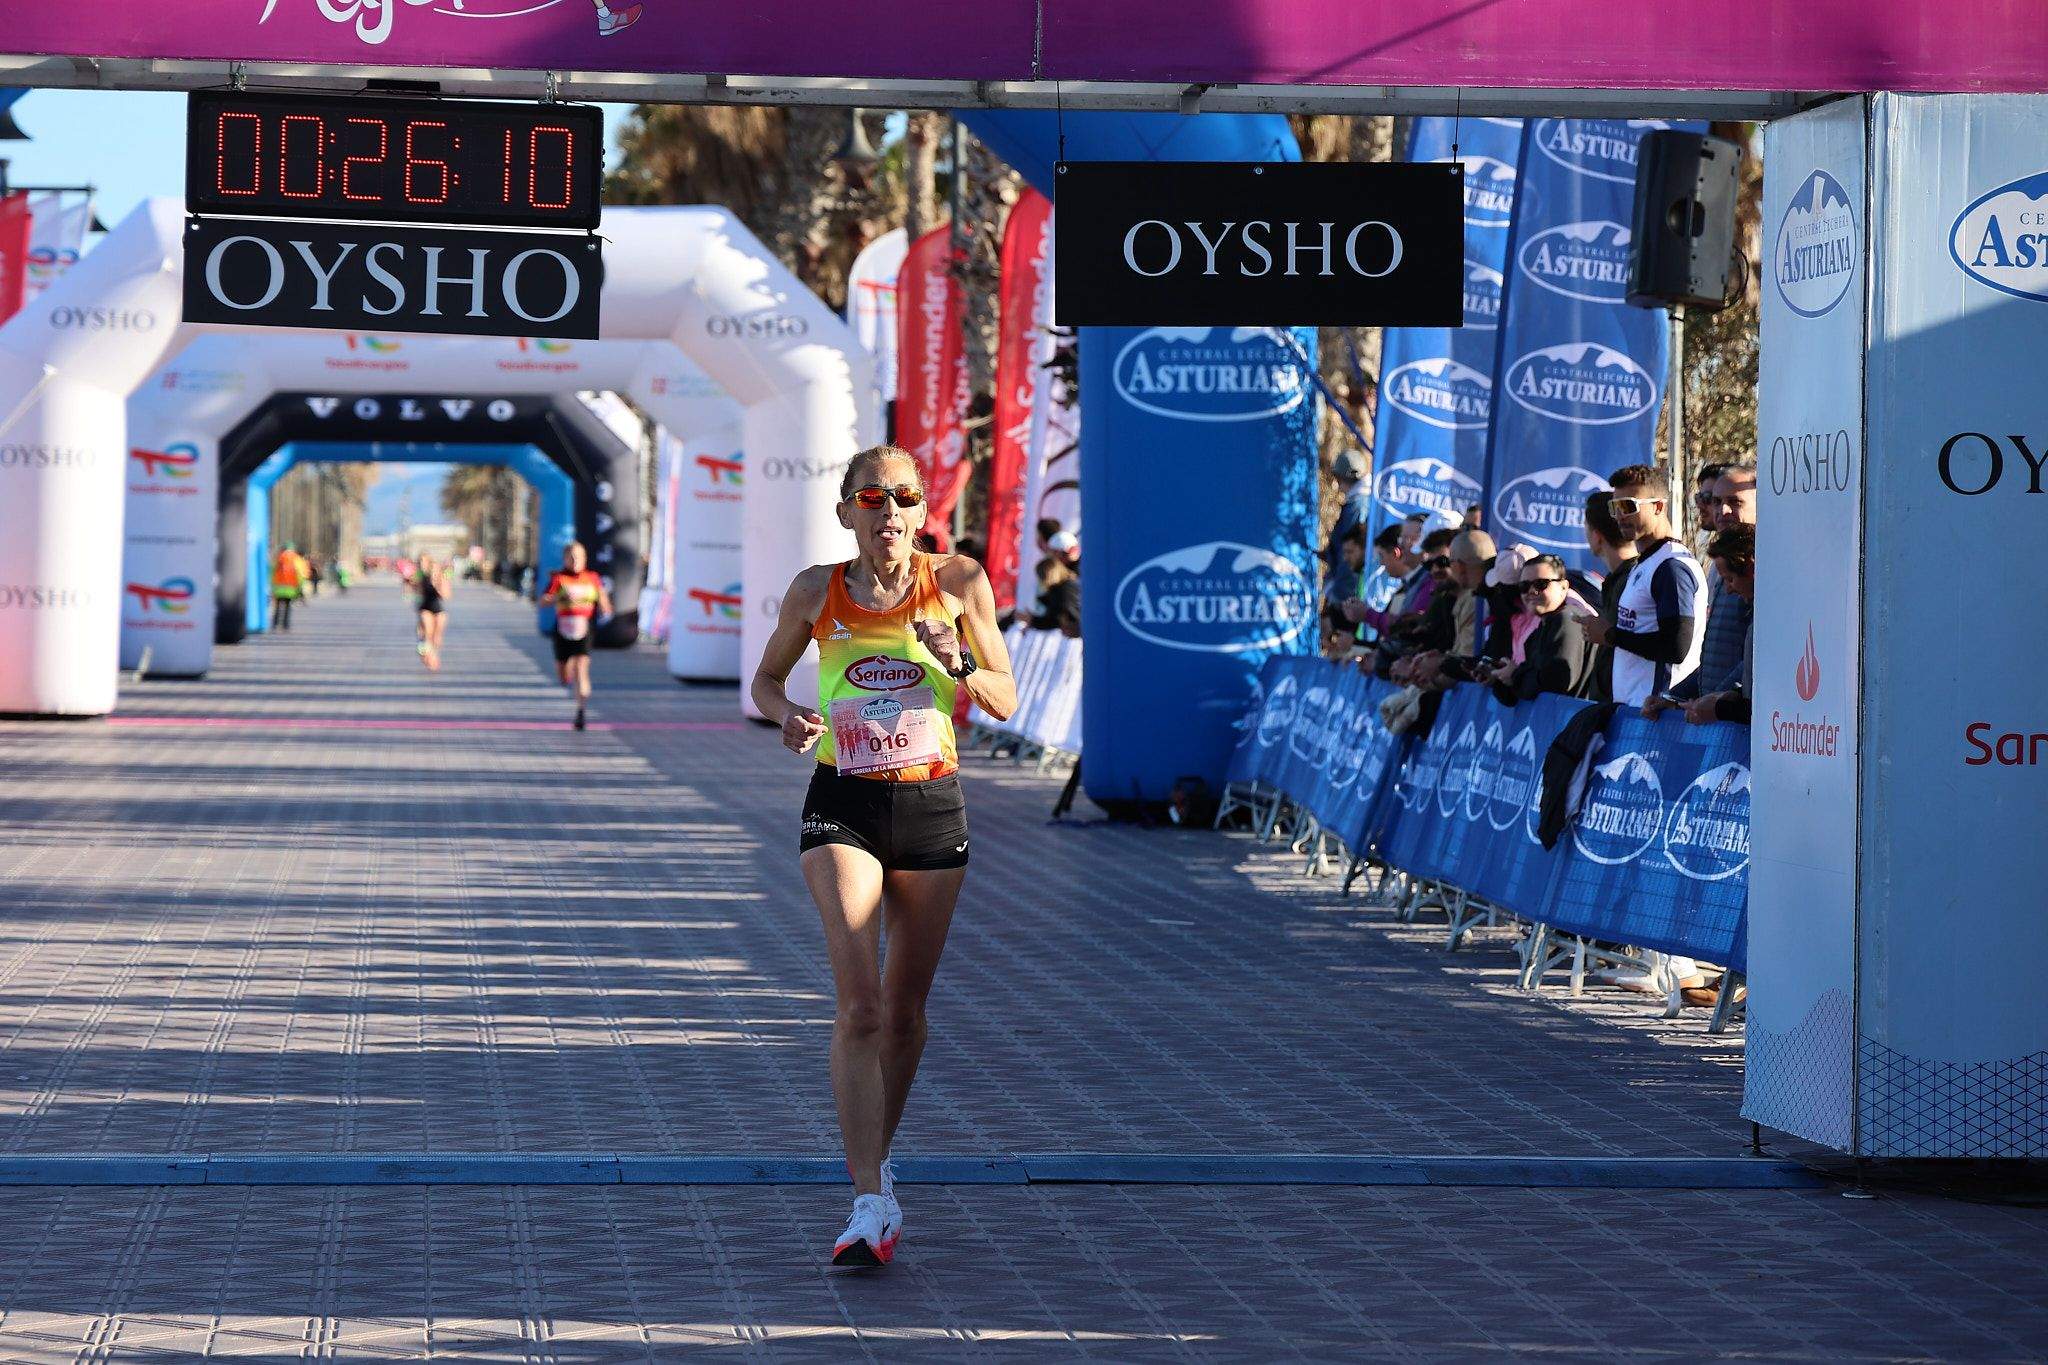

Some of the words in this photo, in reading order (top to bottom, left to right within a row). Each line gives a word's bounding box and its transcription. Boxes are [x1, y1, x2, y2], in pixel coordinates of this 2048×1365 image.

[1122, 219, 1404, 279] OYSHO
[1780, 230, 1852, 284] ASTURIANA
[205, 234, 580, 322] OYSHO
[51, 305, 156, 333] OYSHO
[706, 313, 809, 339] OYSHO
[919, 270, 949, 430] Santander
[1517, 364, 1643, 410] ASTURIANA
[304, 397, 516, 422] VOLVO
[1770, 430, 1851, 495] OYSHO
[854, 666, 919, 683] Serrano
[863, 704, 902, 717] ASTURIANA
[869, 732, 909, 753] 016
[1771, 711, 1840, 757] Santander
[850, 766, 872, 776] CARRERA
[880, 764, 887, 772] LA
[887, 762, 904, 771] MUJER
[883, 754, 893, 763] 17
[1578, 786, 1659, 840] ASTURIANA
